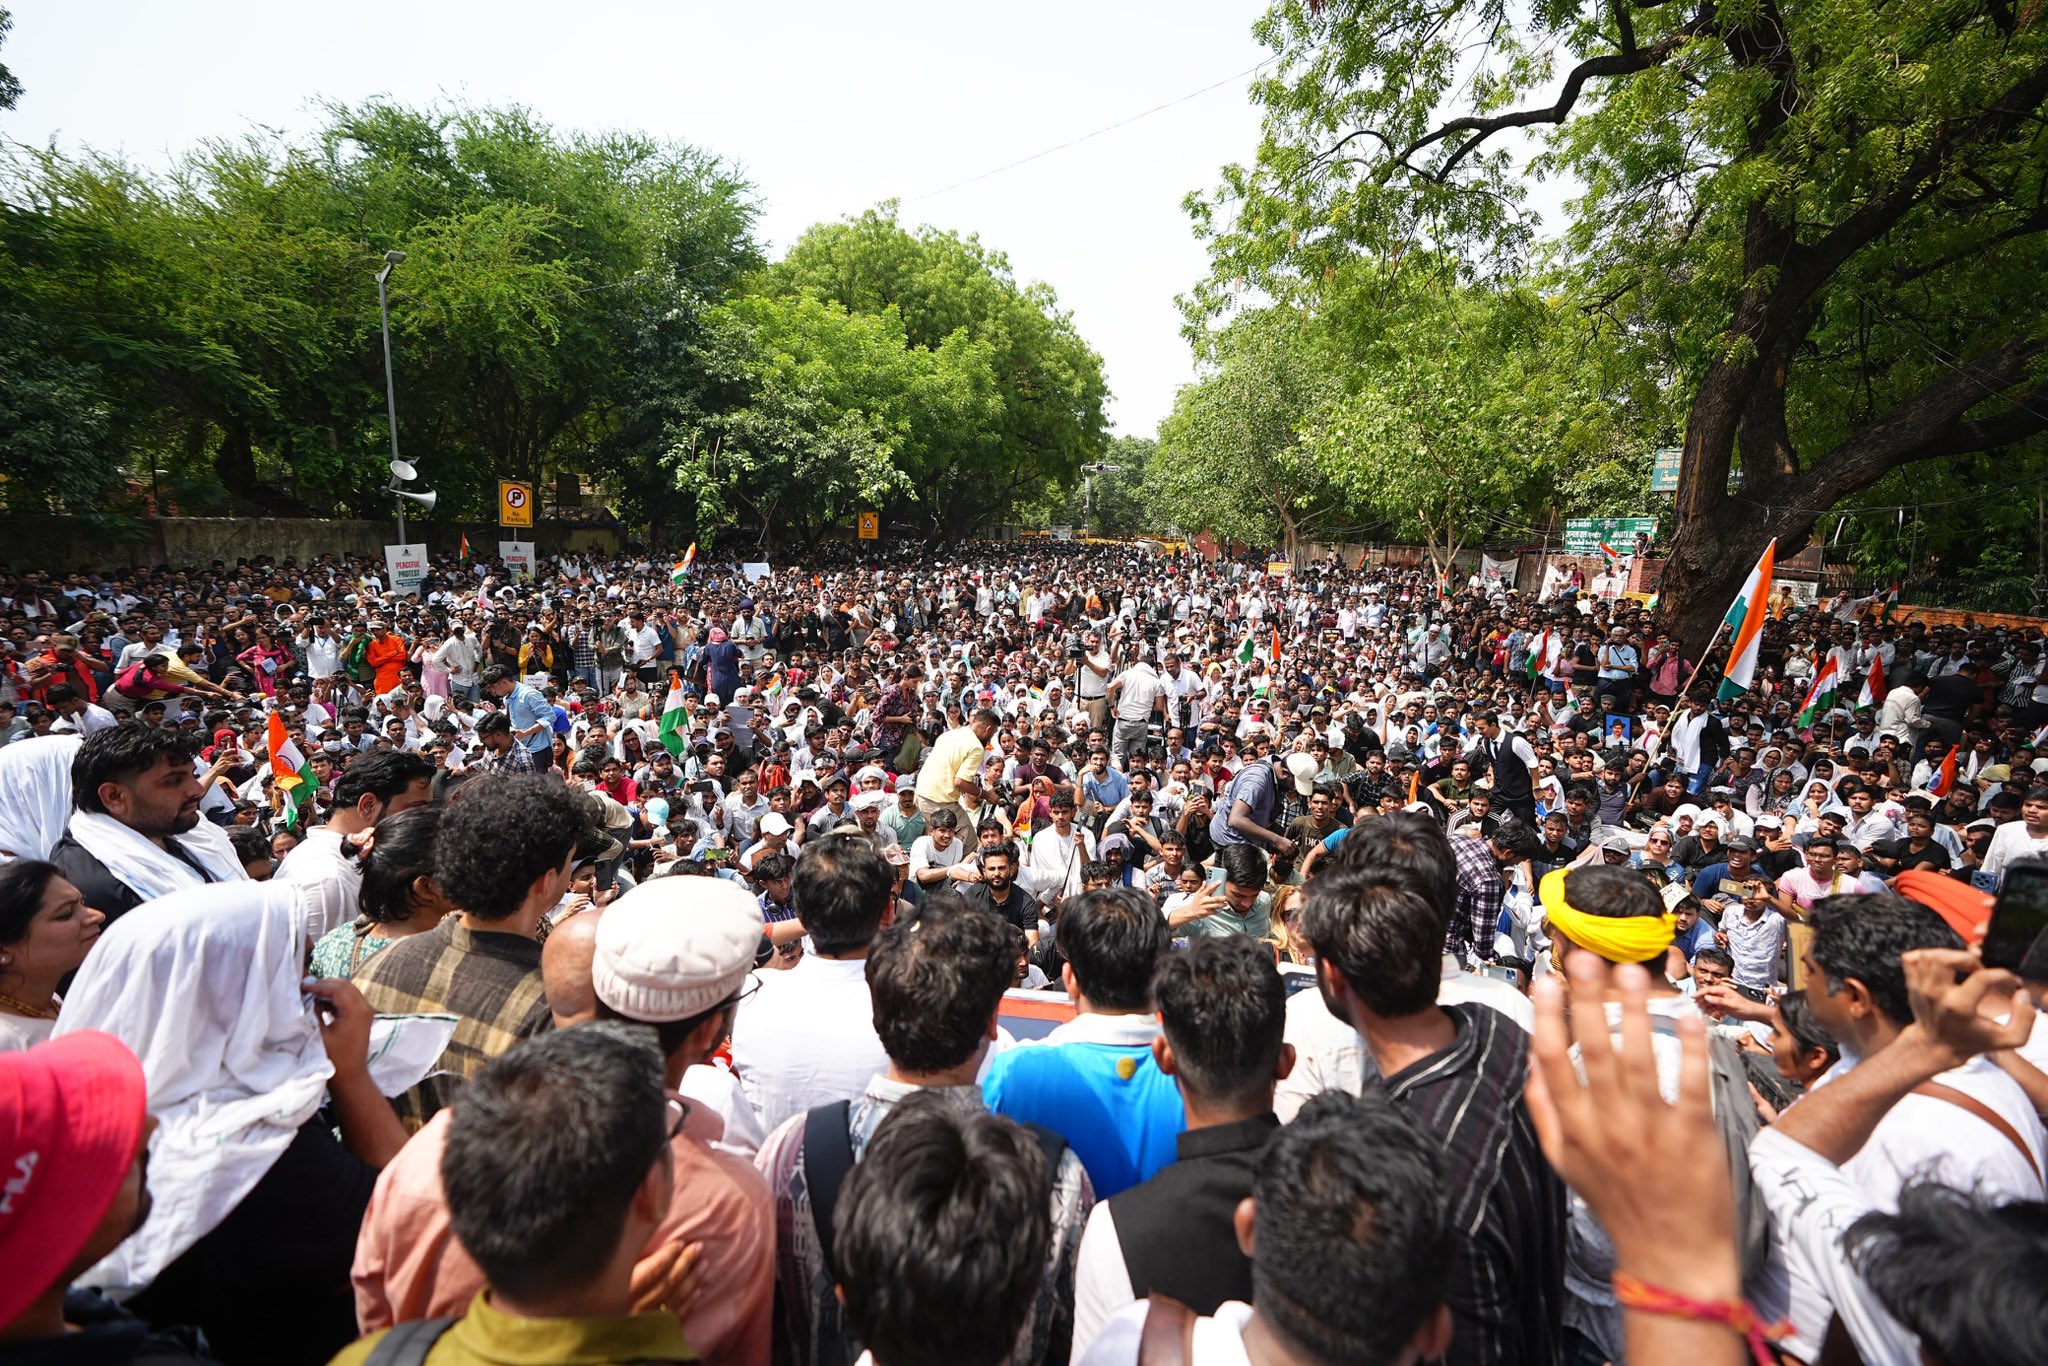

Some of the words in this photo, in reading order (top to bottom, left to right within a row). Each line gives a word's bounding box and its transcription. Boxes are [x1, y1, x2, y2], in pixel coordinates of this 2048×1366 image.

[505, 555, 528, 563] PEACEFUL
[396, 561, 421, 569] PEACEFUL
[398, 569, 420, 578] PROTEST
[1305, 837, 1321, 847] DIO
